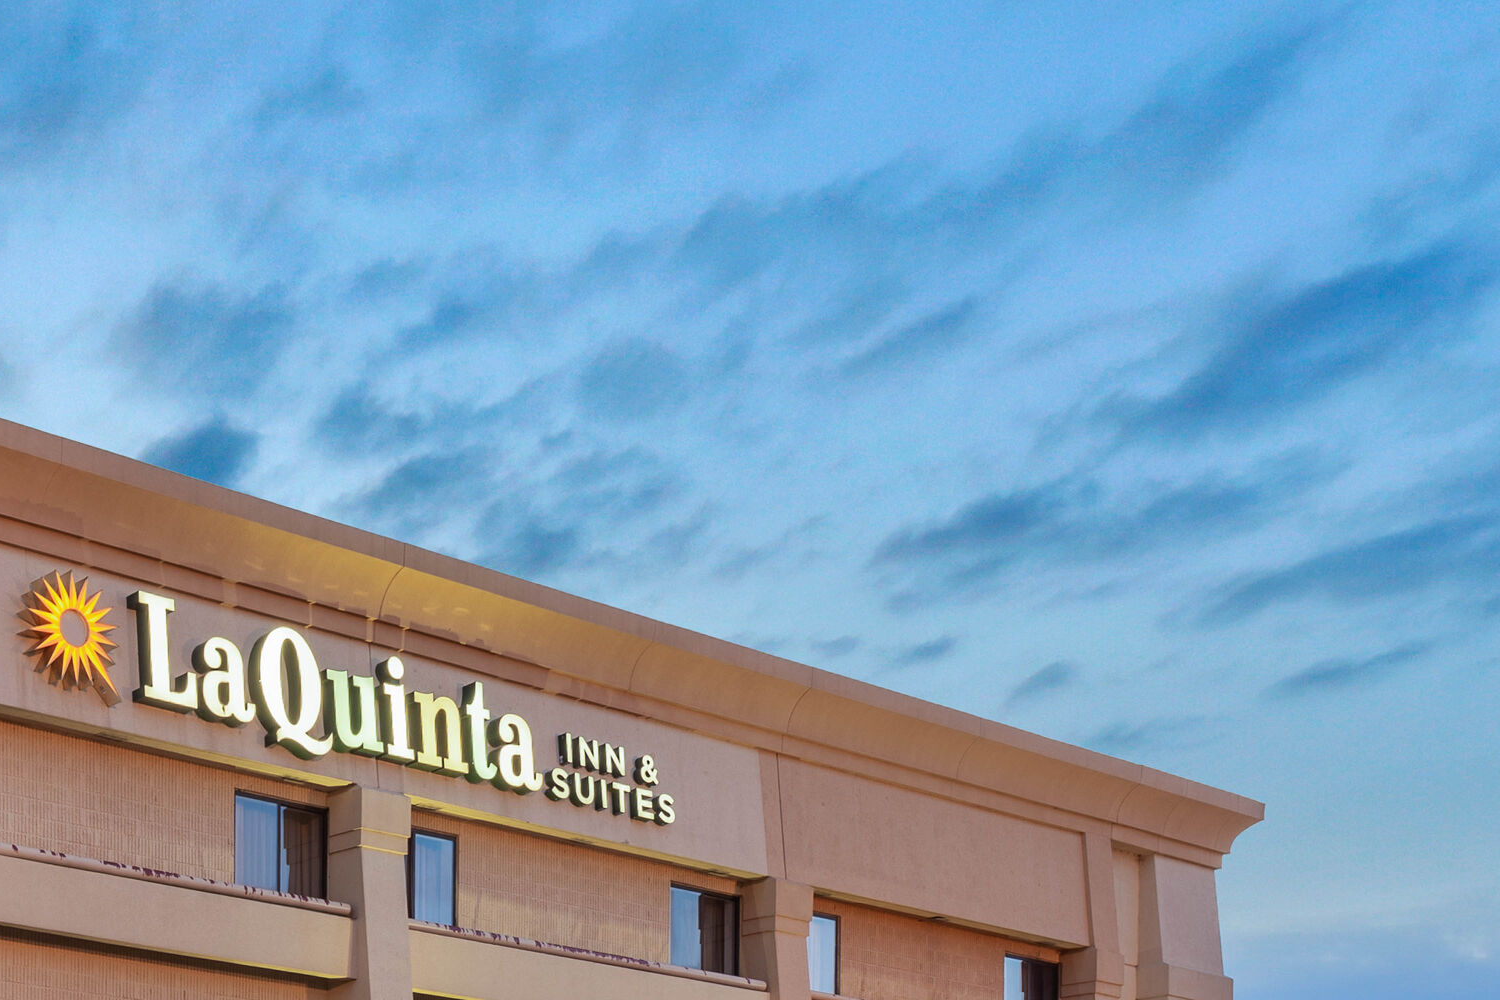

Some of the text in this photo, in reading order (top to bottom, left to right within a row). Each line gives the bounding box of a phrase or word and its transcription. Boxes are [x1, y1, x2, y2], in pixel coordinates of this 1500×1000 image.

[135, 590, 543, 792] LaQuinta
[565, 732, 659, 785] INN &
[550, 767, 676, 824] SUITES
